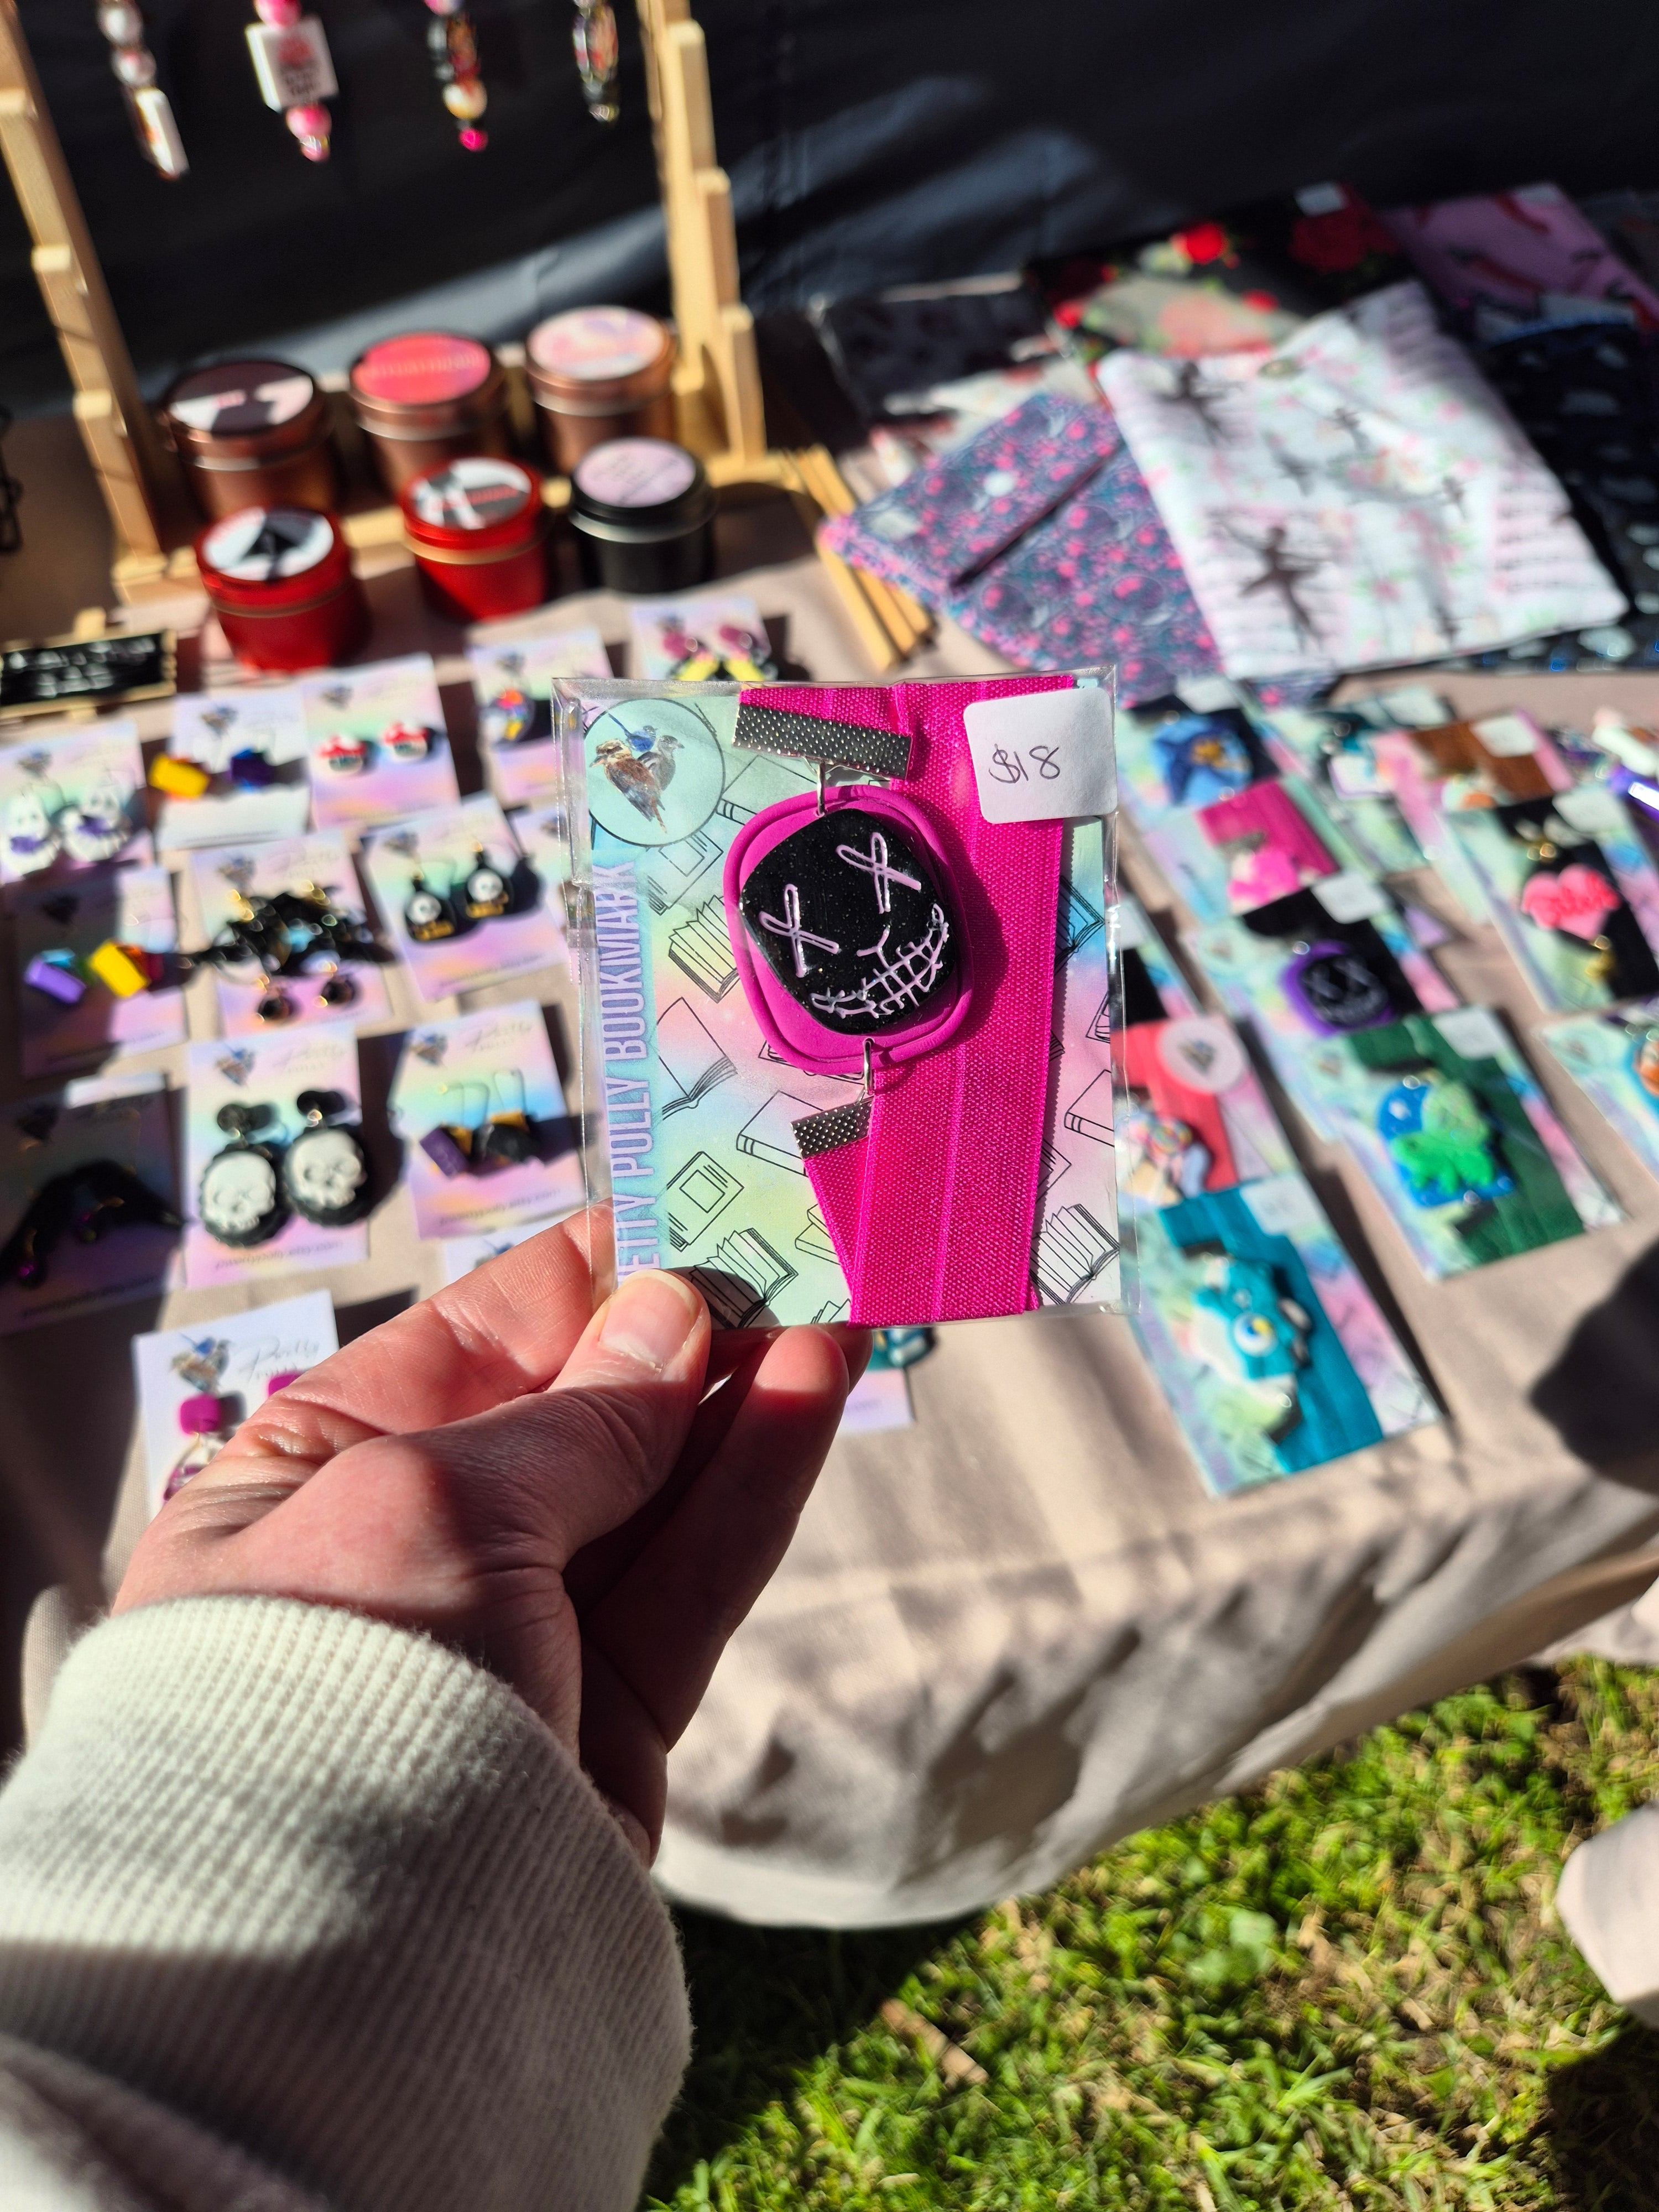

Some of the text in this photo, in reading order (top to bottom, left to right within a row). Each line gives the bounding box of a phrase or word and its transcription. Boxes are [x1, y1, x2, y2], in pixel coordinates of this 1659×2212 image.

[988, 744, 1061, 784] $18
[592, 860, 661, 1287] ETTY POLLY BOOKMARK
